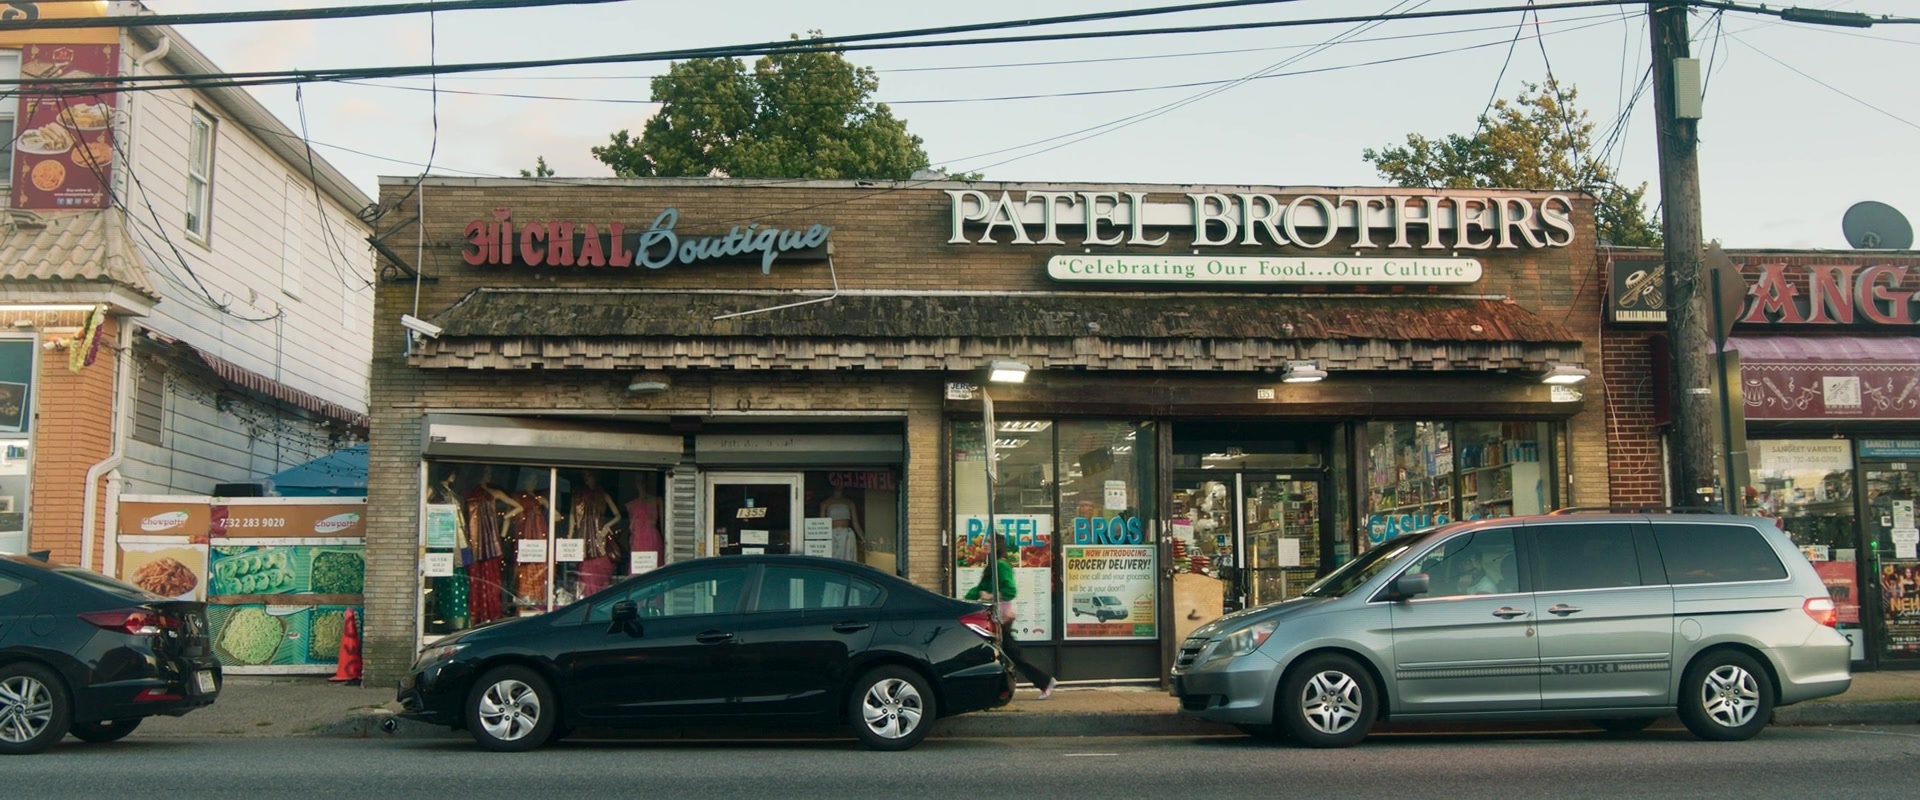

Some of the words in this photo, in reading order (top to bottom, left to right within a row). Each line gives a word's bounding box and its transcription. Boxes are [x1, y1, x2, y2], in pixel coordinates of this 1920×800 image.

[943, 189, 1170, 247] PATEL
[1186, 192, 1576, 250] BROTHERS
[635, 206, 832, 275] Boutique
[1059, 259, 1195, 278] “Celebrating
[1207, 260, 1247, 275] Our
[1384, 261, 1474, 277] Culture”
[1737, 262, 1920, 325] ANG
[739, 508, 765, 517] 1355
[242, 518, 260, 527] 283
[262, 517, 285, 527] 9020
[1367, 513, 1428, 545] CASH
[1073, 516, 1144, 545] BROS
[1085, 549, 1101, 557] NOW
[1068, 559, 1107, 570] GROCERY
[1108, 559, 1151, 570] DELIVERY!
[1112, 574, 1125, 583] your
[1126, 573, 1151, 583] groceries
[1551, 663, 1619, 675] SPORT
